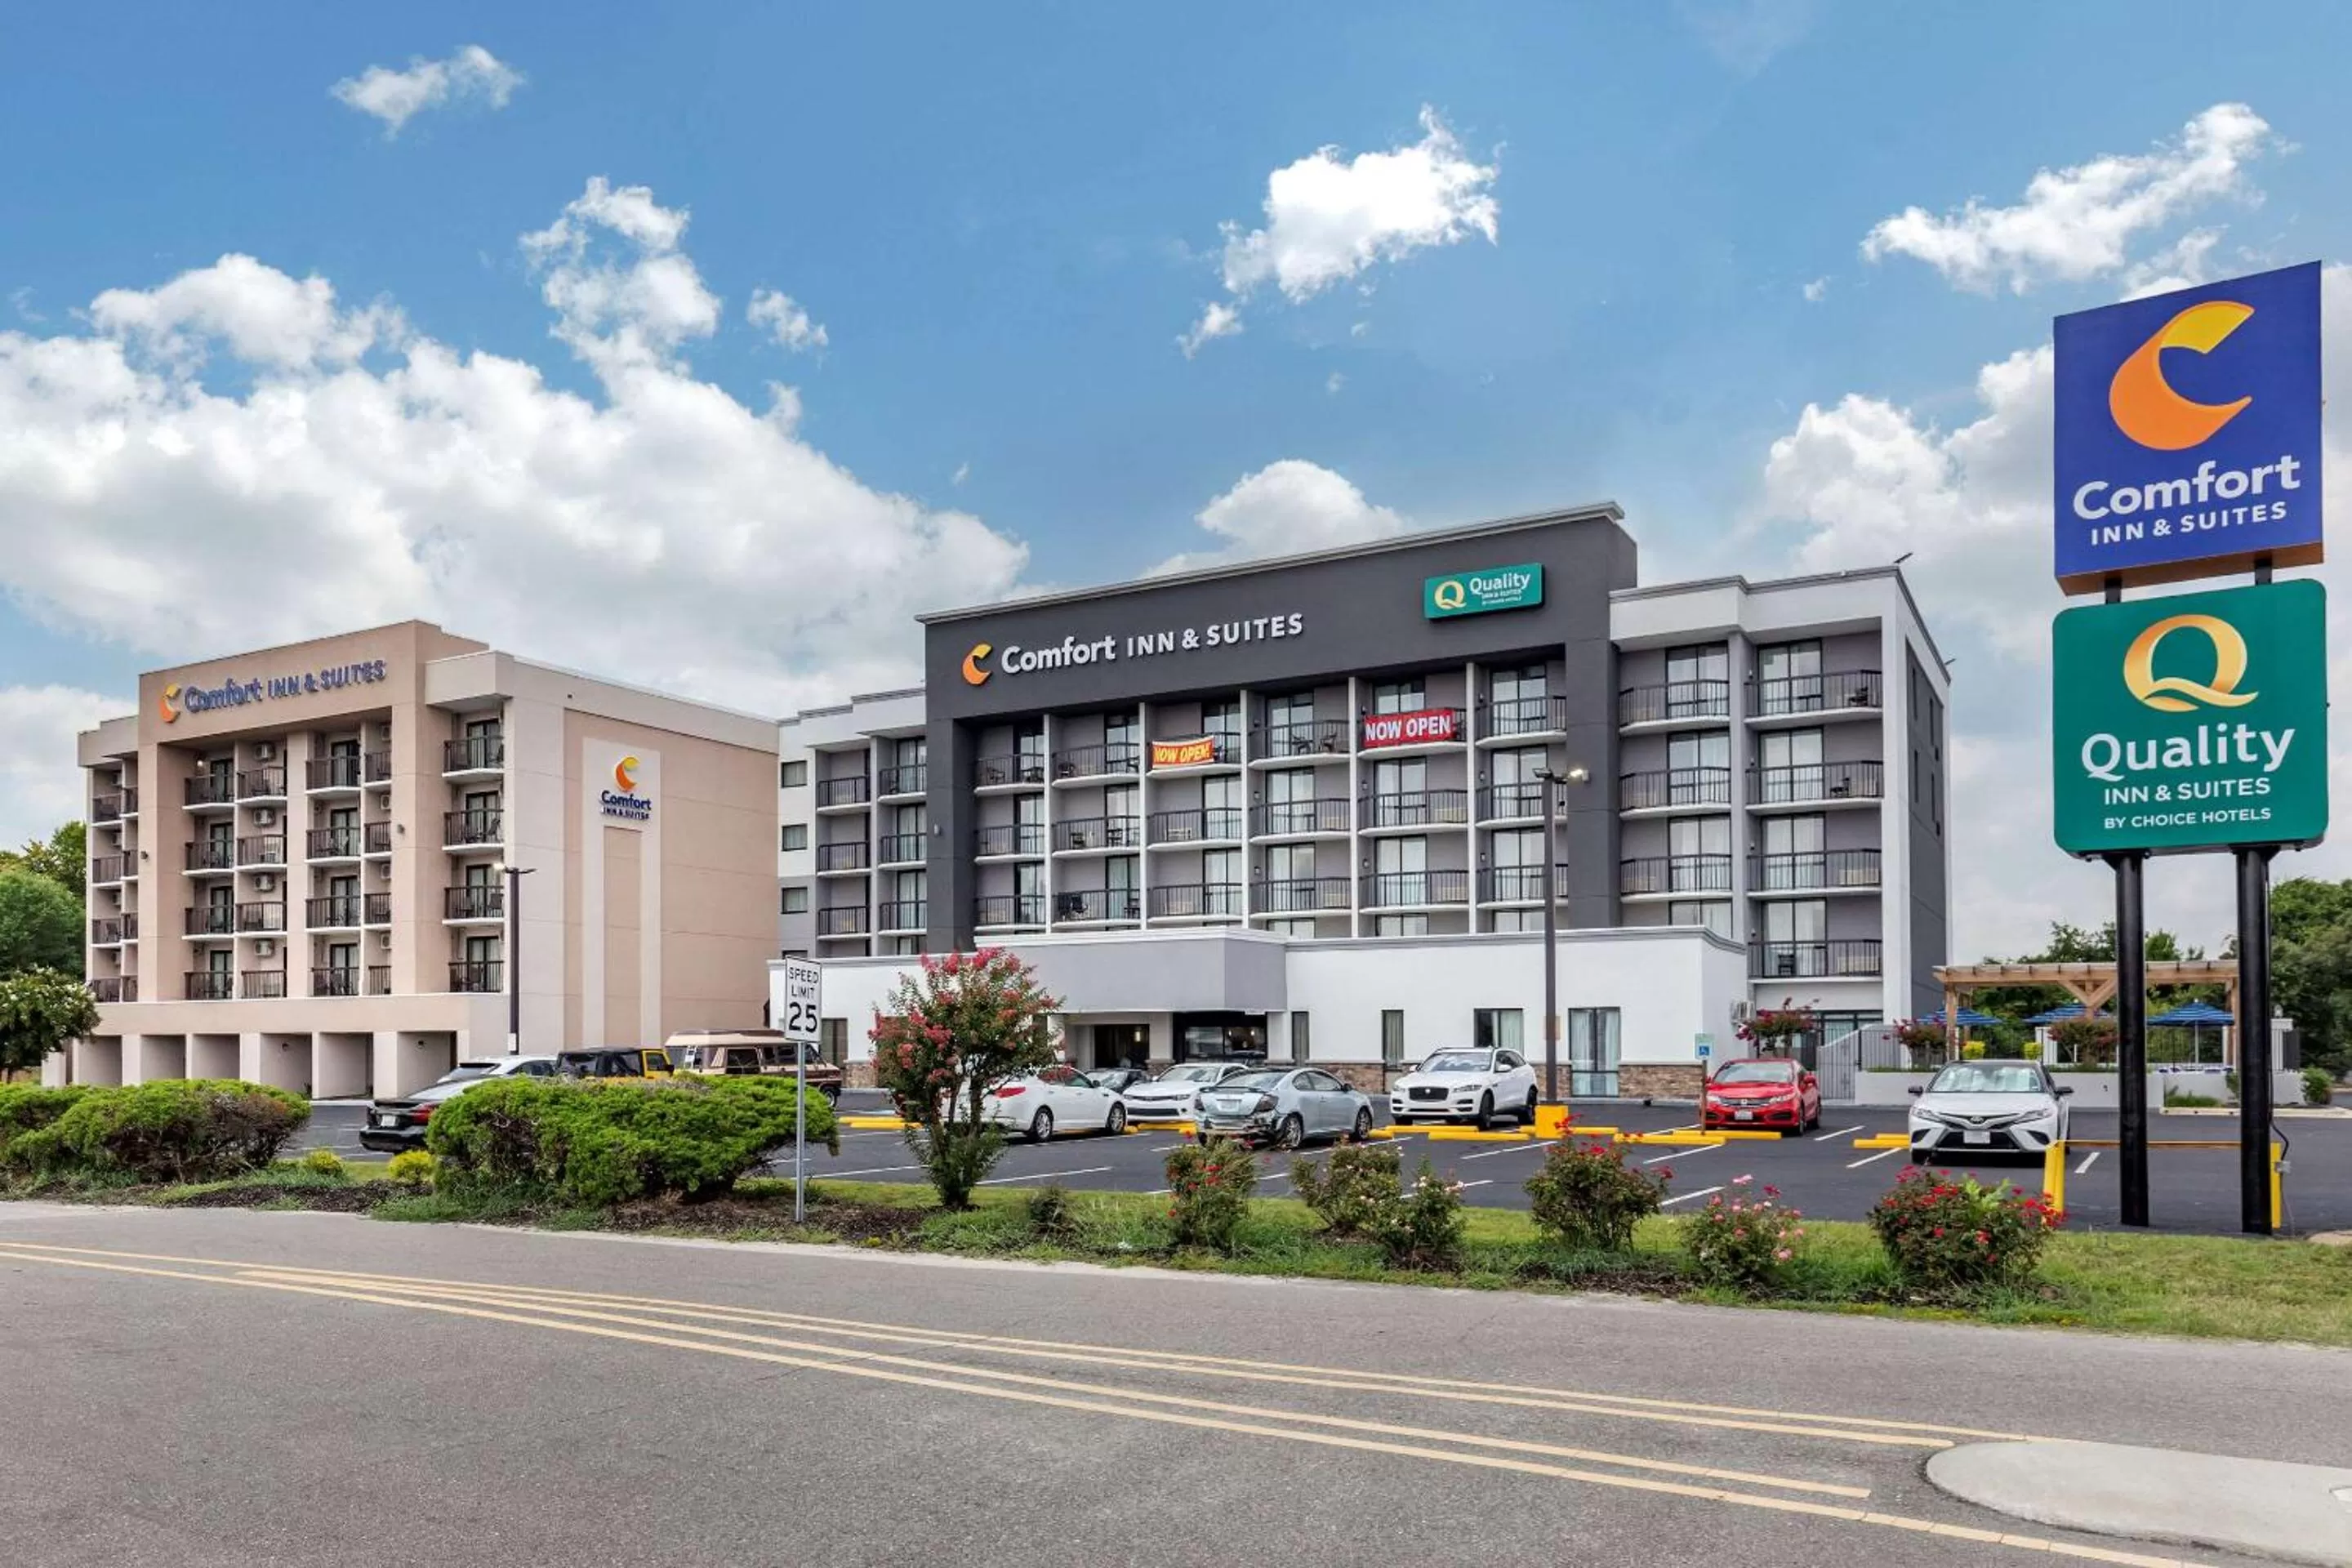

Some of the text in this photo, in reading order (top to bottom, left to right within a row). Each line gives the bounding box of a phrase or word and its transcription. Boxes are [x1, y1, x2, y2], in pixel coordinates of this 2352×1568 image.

[2073, 455, 2301, 519] Comfort
[2091, 501, 2287, 546] INN & SUITES
[1469, 572, 1531, 595] Quality
[1001, 635, 1116, 674] Comfort
[1127, 631, 1174, 657] INN
[1182, 628, 1200, 650] &
[1206, 612, 1303, 646] SUITES
[185, 678, 263, 713] Comfort
[268, 675, 301, 698] INN
[304, 673, 318, 693] &
[320, 660, 386, 690] SUITES
[1365, 715, 1451, 741] NOW OPEN
[1153, 746, 1178, 763] NOW
[2082, 723, 2296, 782] Quality
[601, 790, 652, 811] Comfort
[2105, 777, 2270, 804] INN & SUITES
[2105, 808, 2271, 829] BY CHOICE HOTELS
[789, 967, 819, 983] SPEED
[791, 984, 815, 999] LIMIT
[789, 1001, 817, 1032] 25
